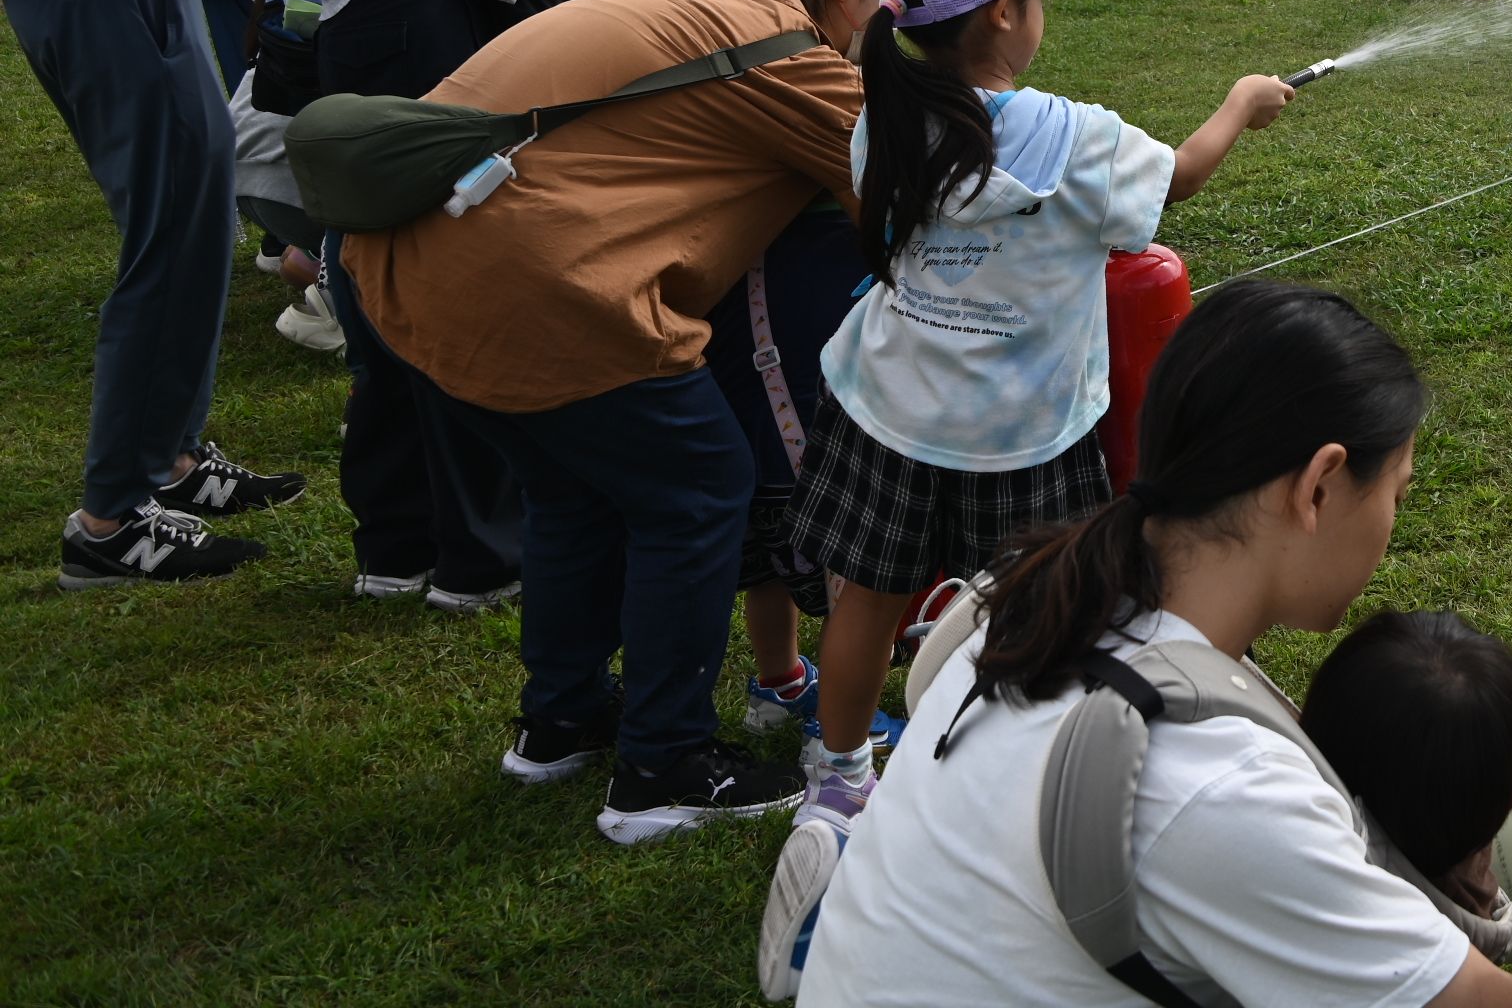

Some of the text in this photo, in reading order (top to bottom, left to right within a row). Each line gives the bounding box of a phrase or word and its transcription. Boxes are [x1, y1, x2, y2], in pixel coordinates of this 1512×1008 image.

[921, 245, 940, 259] you
[961, 241, 991, 255] dream
[921, 258, 941, 272] you
[942, 258, 959, 266] can
[961, 254, 973, 268] do
[919, 303, 961, 318] change
[962, 311, 990, 321] your
[933, 296, 960, 305] your
[961, 297, 1013, 312] thoughts
[905, 310, 920, 322] long
[930, 320, 949, 330] there
[963, 326, 980, 334] stars
[981, 328, 1003, 337] above
[192, 474, 238, 508] N
[119, 535, 177, 573] N
